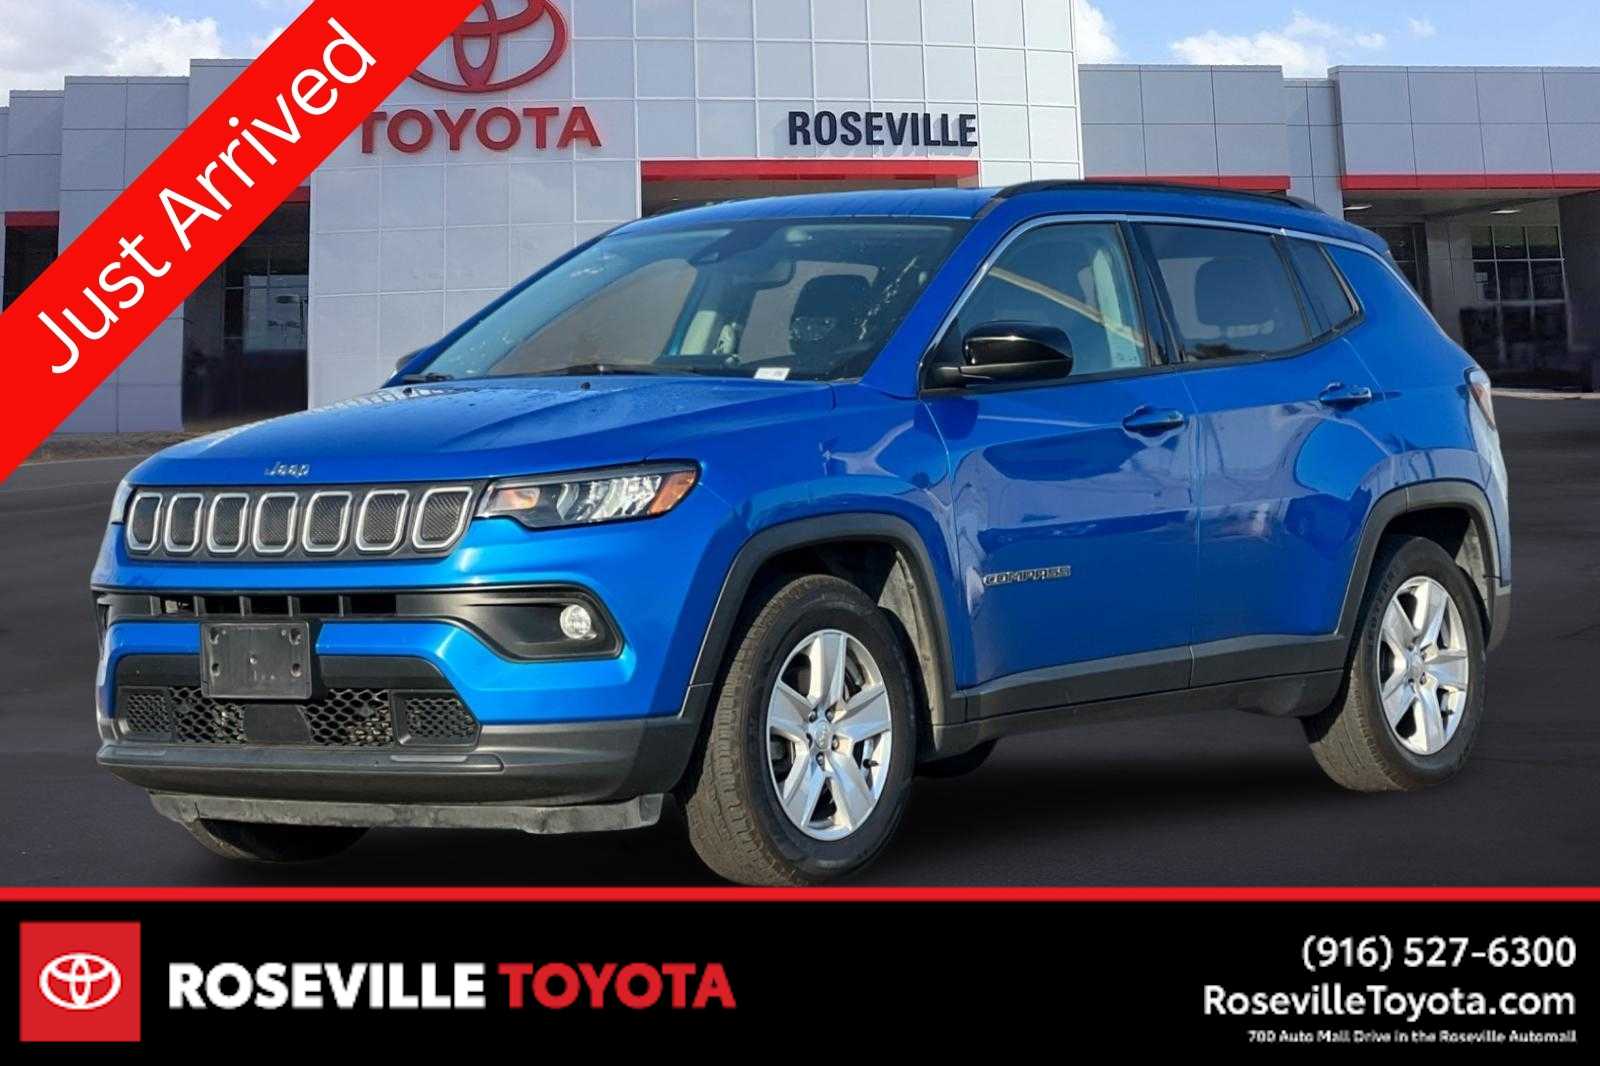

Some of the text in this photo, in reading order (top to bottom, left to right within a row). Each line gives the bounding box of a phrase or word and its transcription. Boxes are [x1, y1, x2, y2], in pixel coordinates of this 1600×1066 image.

[361, 106, 602, 153] TOYOTA
[788, 110, 978, 147] ROSEVILLE
[264, 461, 310, 479] Jeep
[982, 565, 1072, 586] COMPASS
